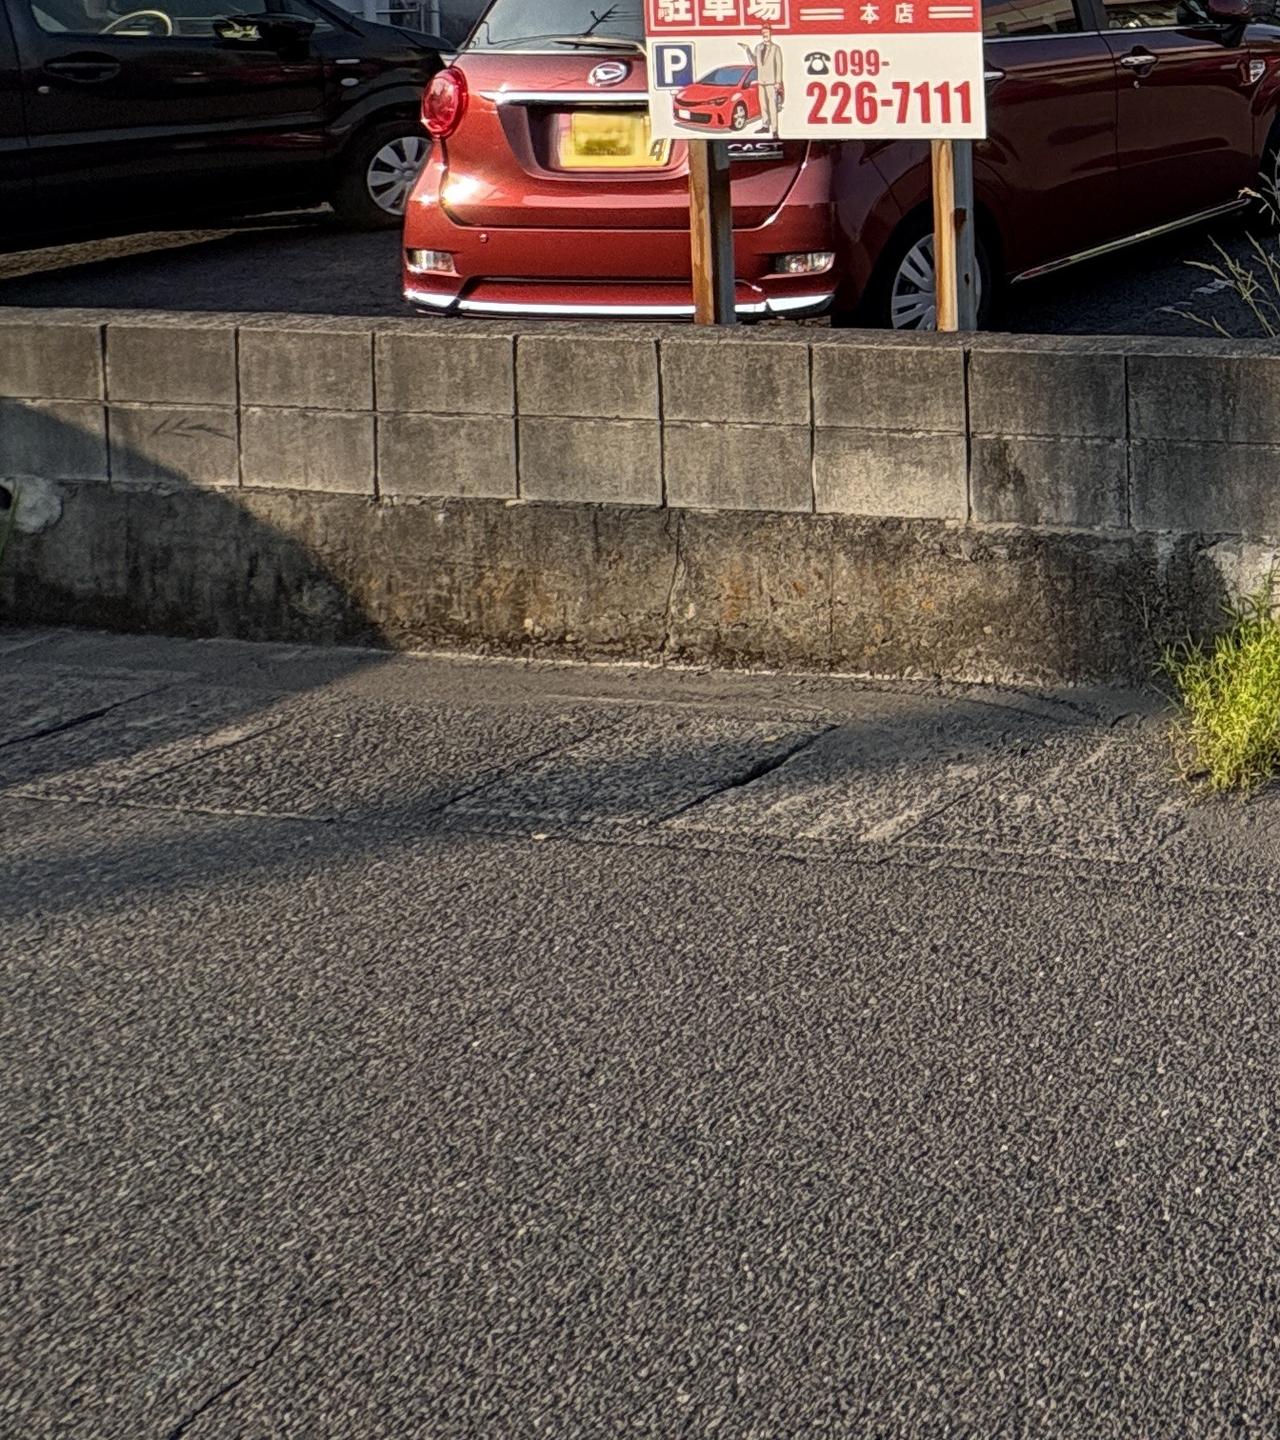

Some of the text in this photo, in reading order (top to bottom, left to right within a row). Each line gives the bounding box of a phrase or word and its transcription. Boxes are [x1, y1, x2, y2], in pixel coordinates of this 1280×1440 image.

[860, 3, 914, 24] 本店
[663, 48, 688, 84] P
[834, 49, 890, 77] 099-
[806, 80, 972, 125] 226-7111
